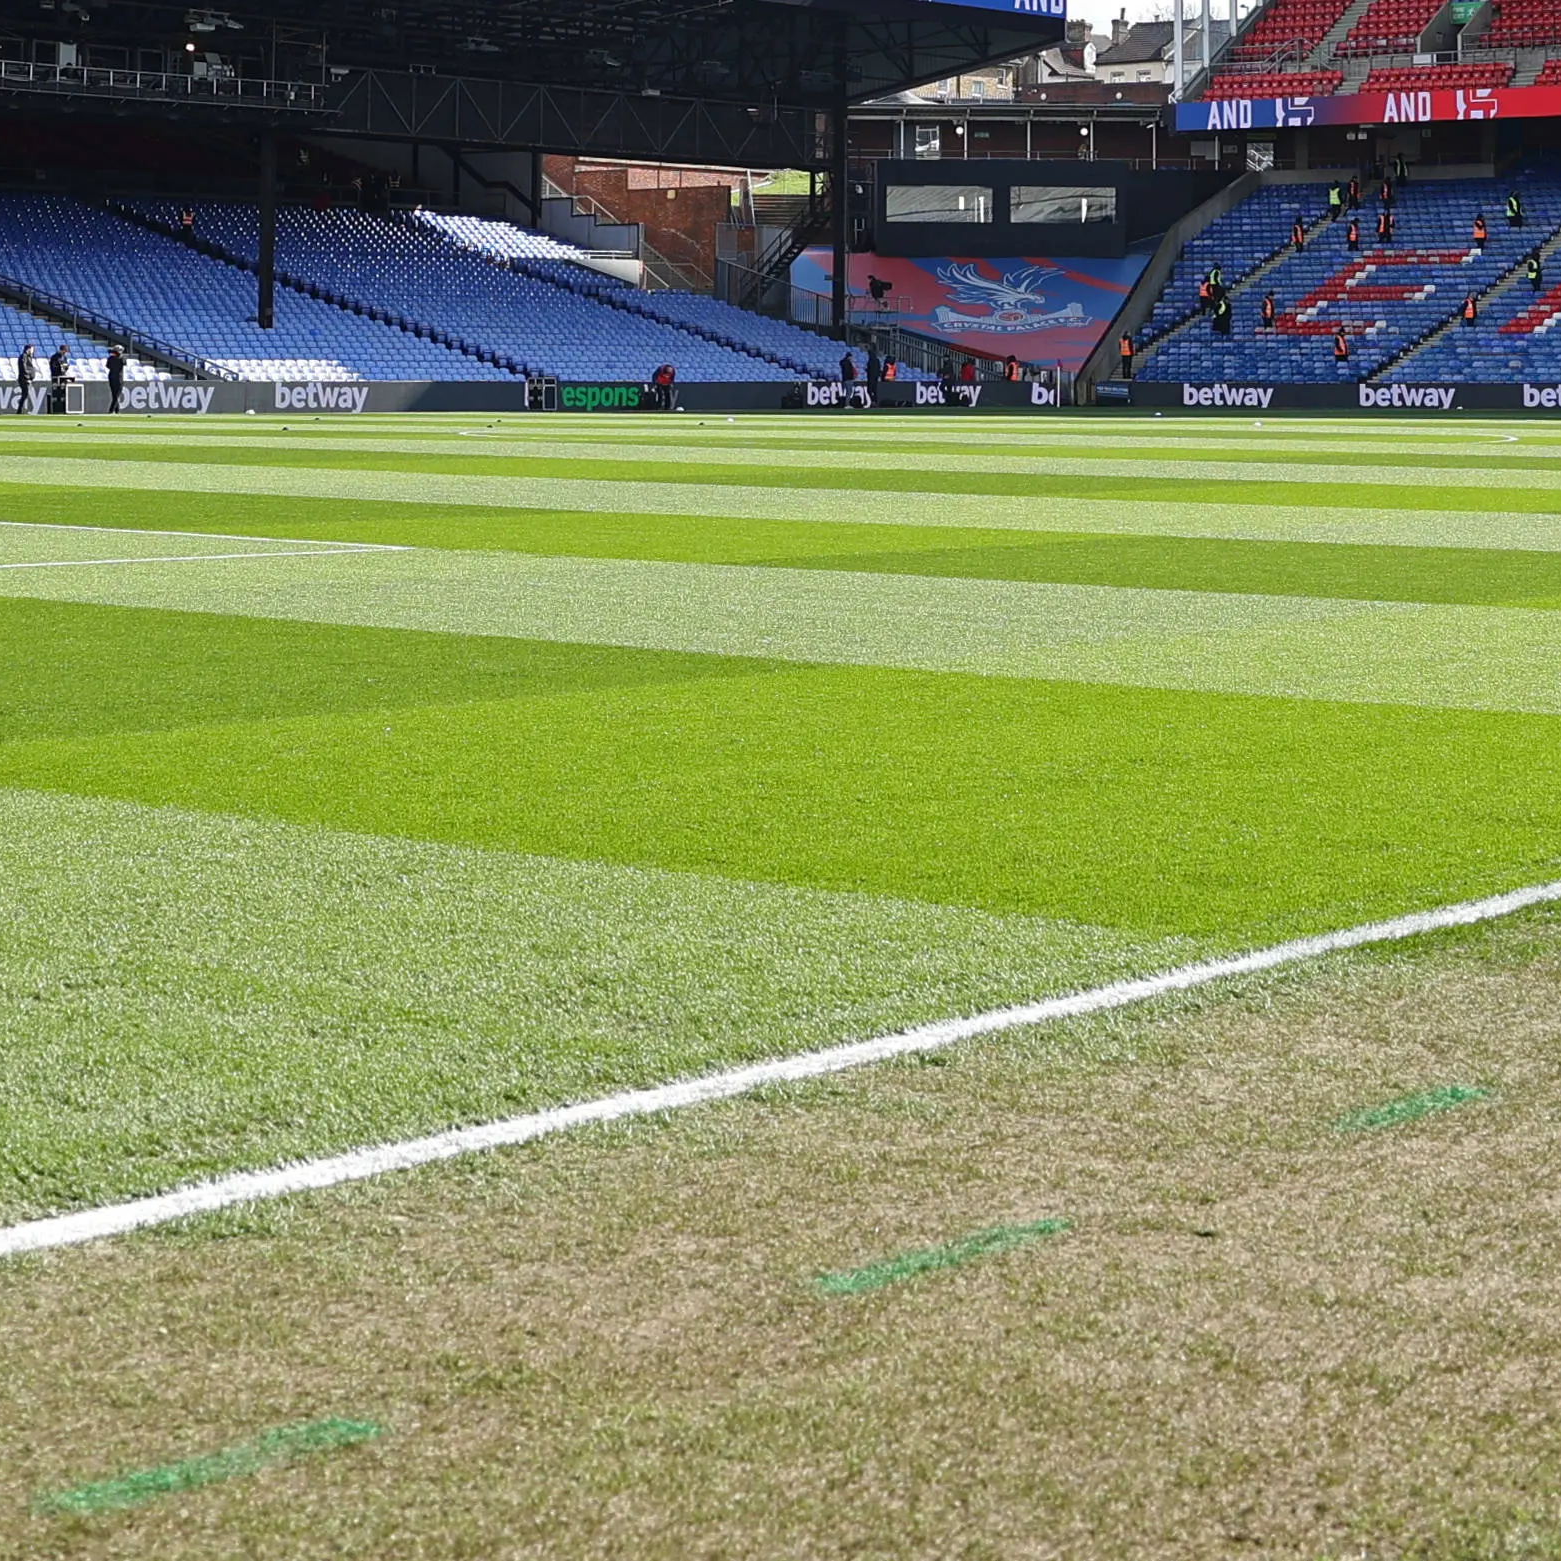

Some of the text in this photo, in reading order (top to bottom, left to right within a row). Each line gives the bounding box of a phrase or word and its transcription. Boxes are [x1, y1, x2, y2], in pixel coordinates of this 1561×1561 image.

[1207, 99, 1253, 130] AND
[1383, 91, 1432, 123] AND
[943, 322, 1003, 332] CRYSTAL
[1006, 320, 1057, 331] PALACE
[118, 381, 215, 414] betway
[274, 382, 368, 414] betway
[560, 386, 639, 411] espons
[1183, 384, 1274, 408] betway
[1359, 384, 1455, 409] betway
